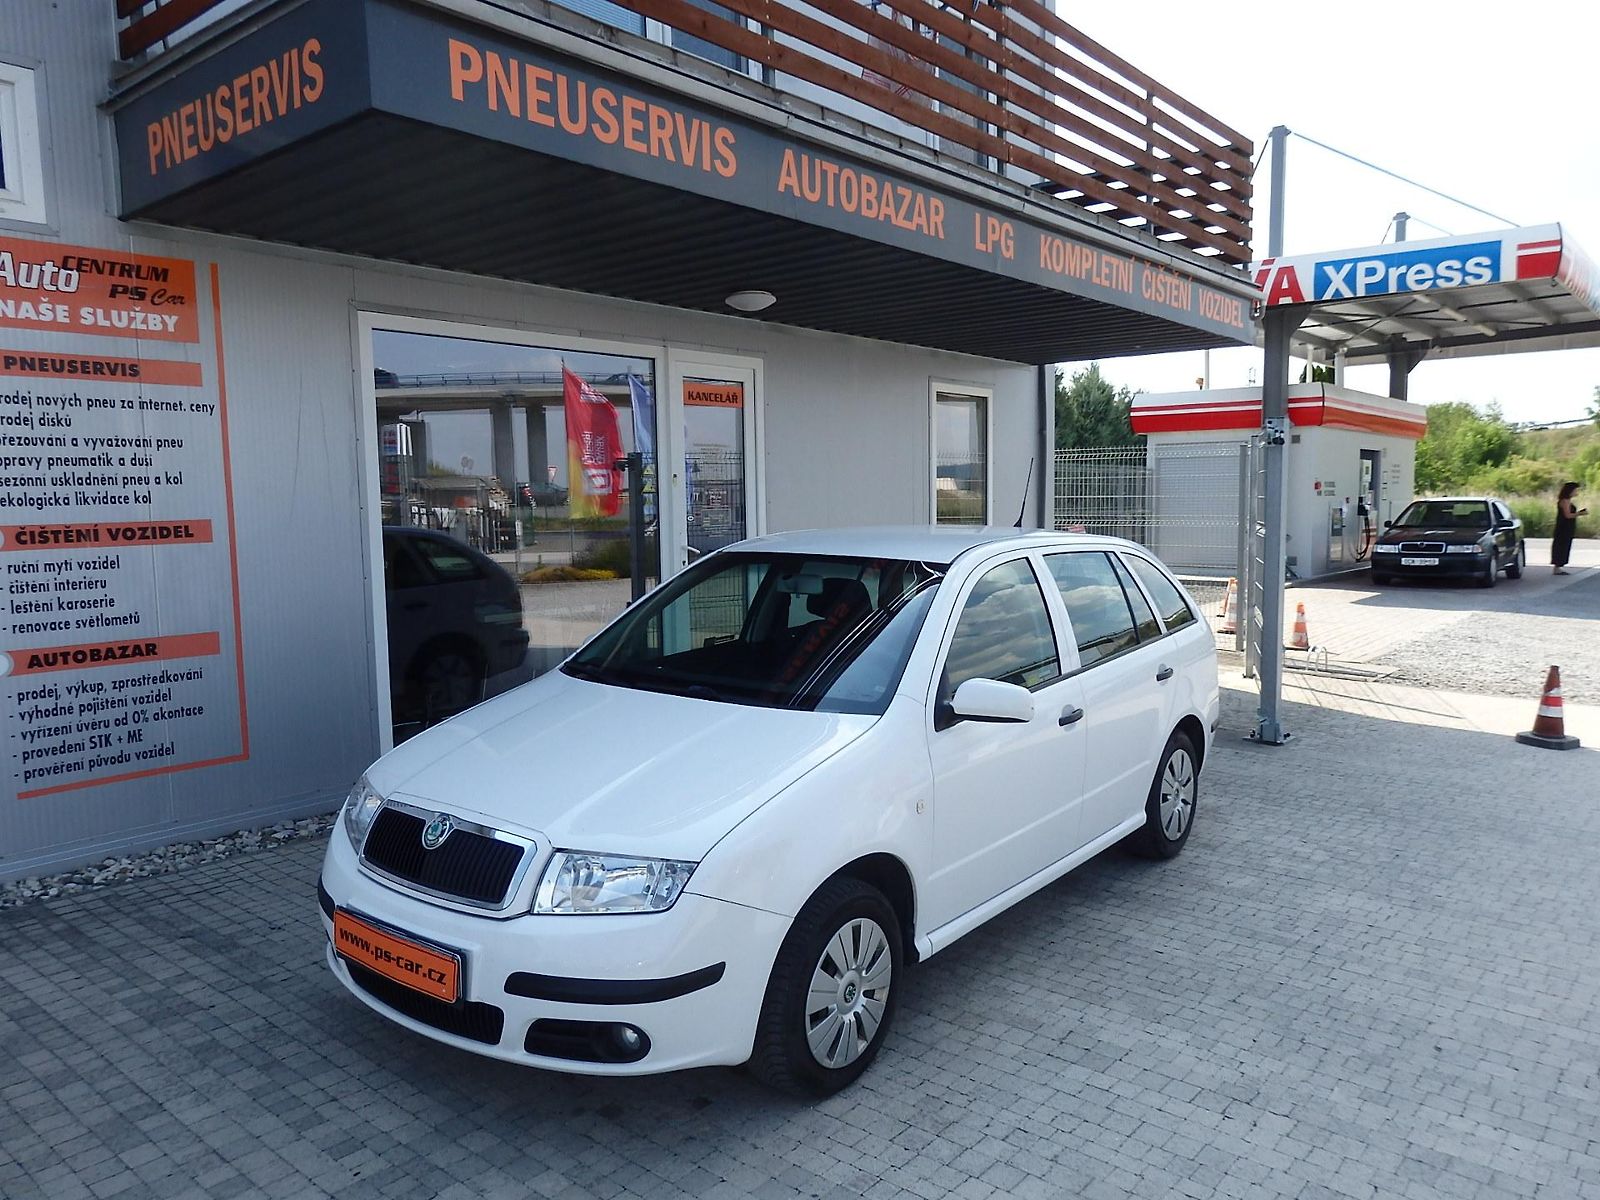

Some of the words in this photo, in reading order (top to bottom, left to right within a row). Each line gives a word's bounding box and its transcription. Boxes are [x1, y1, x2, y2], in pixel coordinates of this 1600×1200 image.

[147, 38, 324, 175] PNEUSERVIS
[448, 38, 737, 177] PNEUSERVIS
[778, 148, 945, 239] AUTOBAZAR
[975, 212, 1014, 260] LPG
[1040, 234, 1136, 294] KOMPLETNÍ
[1142, 260, 1193, 312] ČIŠTĚNÍ
[1198, 288, 1244, 328] VOZIDEL
[61, 255, 169, 283] CENTRUM
[1322, 255, 1493, 301] XPress
[109, 284, 148, 302] PS
[150, 288, 186, 306] Car
[0, 297, 70, 323] NAŠE
[80, 305, 180, 332] SLUŽBY
[4, 355, 141, 378] PNEUSERVIS
[37, 392, 82, 410] nových
[87, 398, 116, 411] pneu
[120, 399, 134, 410] za
[139, 396, 186, 412] internet.
[190, 402, 215, 416] ceny
[687, 390, 739, 404] KANCELÁŘ
[38, 412, 72, 427] disků
[0, 433, 66, 447] řezouvání
[70, 436, 78, 447] a
[83, 434, 152, 451] vyvažování
[156, 437, 184, 451] pneu
[48, 453, 114, 470] pneumatik
[118, 456, 126, 467] a
[51, 472, 118, 487] uskladnění
[122, 475, 150, 489] pneu
[154, 475, 161, 486] a
[165, 471, 183, 486] kol
[0, 492, 70, 510] ekologická
[75, 491, 130, 505] likvidace
[134, 490, 152, 504] kol
[15, 524, 100, 545] ČIŠTĚNÍ
[106, 525, 194, 541] VOZIDEL
[7, 559, 39, 574] ruční
[77, 555, 120, 571] vozidel
[9, 578, 50, 594] čištění
[54, 576, 107, 591] interiéru
[10, 598, 53, 614] leštění
[57, 594, 115, 611] karoserie
[12, 621, 71, 634] renovace
[75, 611, 140, 629] světlometů
[27, 643, 158, 669] AUTOBAZAR
[17, 683, 61, 705] prodej,
[65, 680, 107, 700] výkup,
[111, 667, 203, 692] zprostředkování
[18, 702, 74, 724] výhodné
[78, 695, 128, 716] pojištění
[132, 688, 172, 706] vozidel
[21, 721, 73, 744] vyřízení
[76, 715, 110, 732] úvěru
[114, 711, 128, 728] od
[132, 709, 150, 724] 0%
[152, 705, 204, 722] akontace
[22, 738, 85, 764] provedení
[89, 733, 113, 751] STK
[127, 729, 144, 745] ME
[24, 757, 84, 783] prověření
[88, 751, 131, 771] původu
[134, 742, 175, 761] vozidel
[340, 927, 446, 985] www.ps-car.cz
